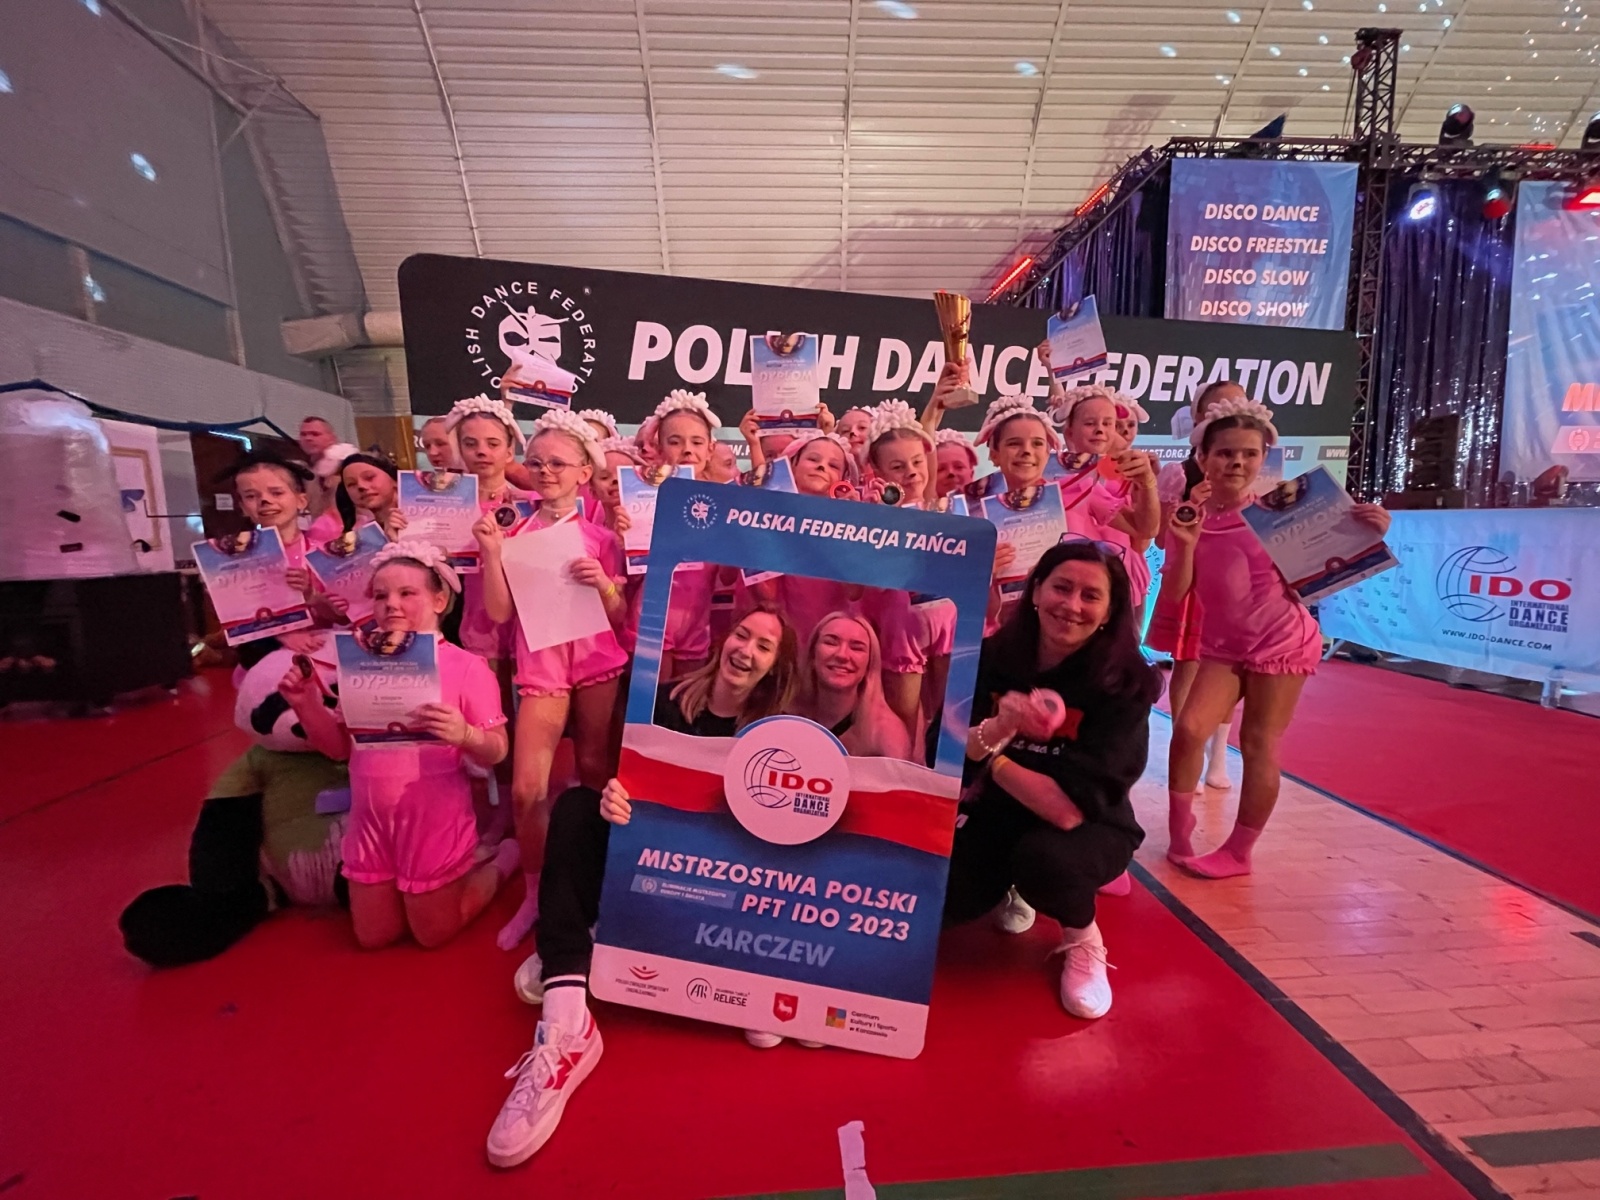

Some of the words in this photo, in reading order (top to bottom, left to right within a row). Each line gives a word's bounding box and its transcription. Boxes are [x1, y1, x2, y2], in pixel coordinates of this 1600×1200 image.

[1204, 203, 1258, 221] DISCO
[1261, 204, 1320, 222] DANCE
[1190, 235, 1242, 252] DISCO
[1246, 237, 1329, 255] FREESTYLE
[1204, 268, 1257, 285] DISCO
[1260, 269, 1310, 286] SLOW
[471, 281, 538, 319] DANCE
[1200, 300, 1252, 316] DISCO
[1256, 301, 1309, 318] SHOW
[549, 288, 597, 394] FEDERATIO
[465, 328, 502, 389] OLISH
[627, 320, 861, 390] POLH
[871, 337, 1051, 398] DANCE
[726, 508, 796, 533] POLSKA
[799, 518, 899, 549] FEDERACJA
[904, 532, 967, 557] TAŃCA
[1148, 545, 1160, 592] EDERATIO
[1469, 574, 1572, 602] IDO
[1509, 607, 1568, 626] DANCE
[1510, 600, 1569, 612] INTERNATIONAL
[1508, 620, 1568, 633] ORGANIZATION
[1442, 628, 1552, 651] WWW.IDO-DANCE.COM
[768, 770, 833, 795] IDO
[794, 797, 830, 812] DANCE
[637, 848, 817, 896] MISTRZOSTWA
[824, 880, 917, 914] POLSKI
[741, 894, 786, 918] PFT
[791, 902, 840, 928] IDO
[848, 913, 910, 941] 2023
[694, 922, 835, 967] KARCZEW
[713, 992, 748, 1008] RELIESE
[851, 1010, 880, 1021] Centrum
